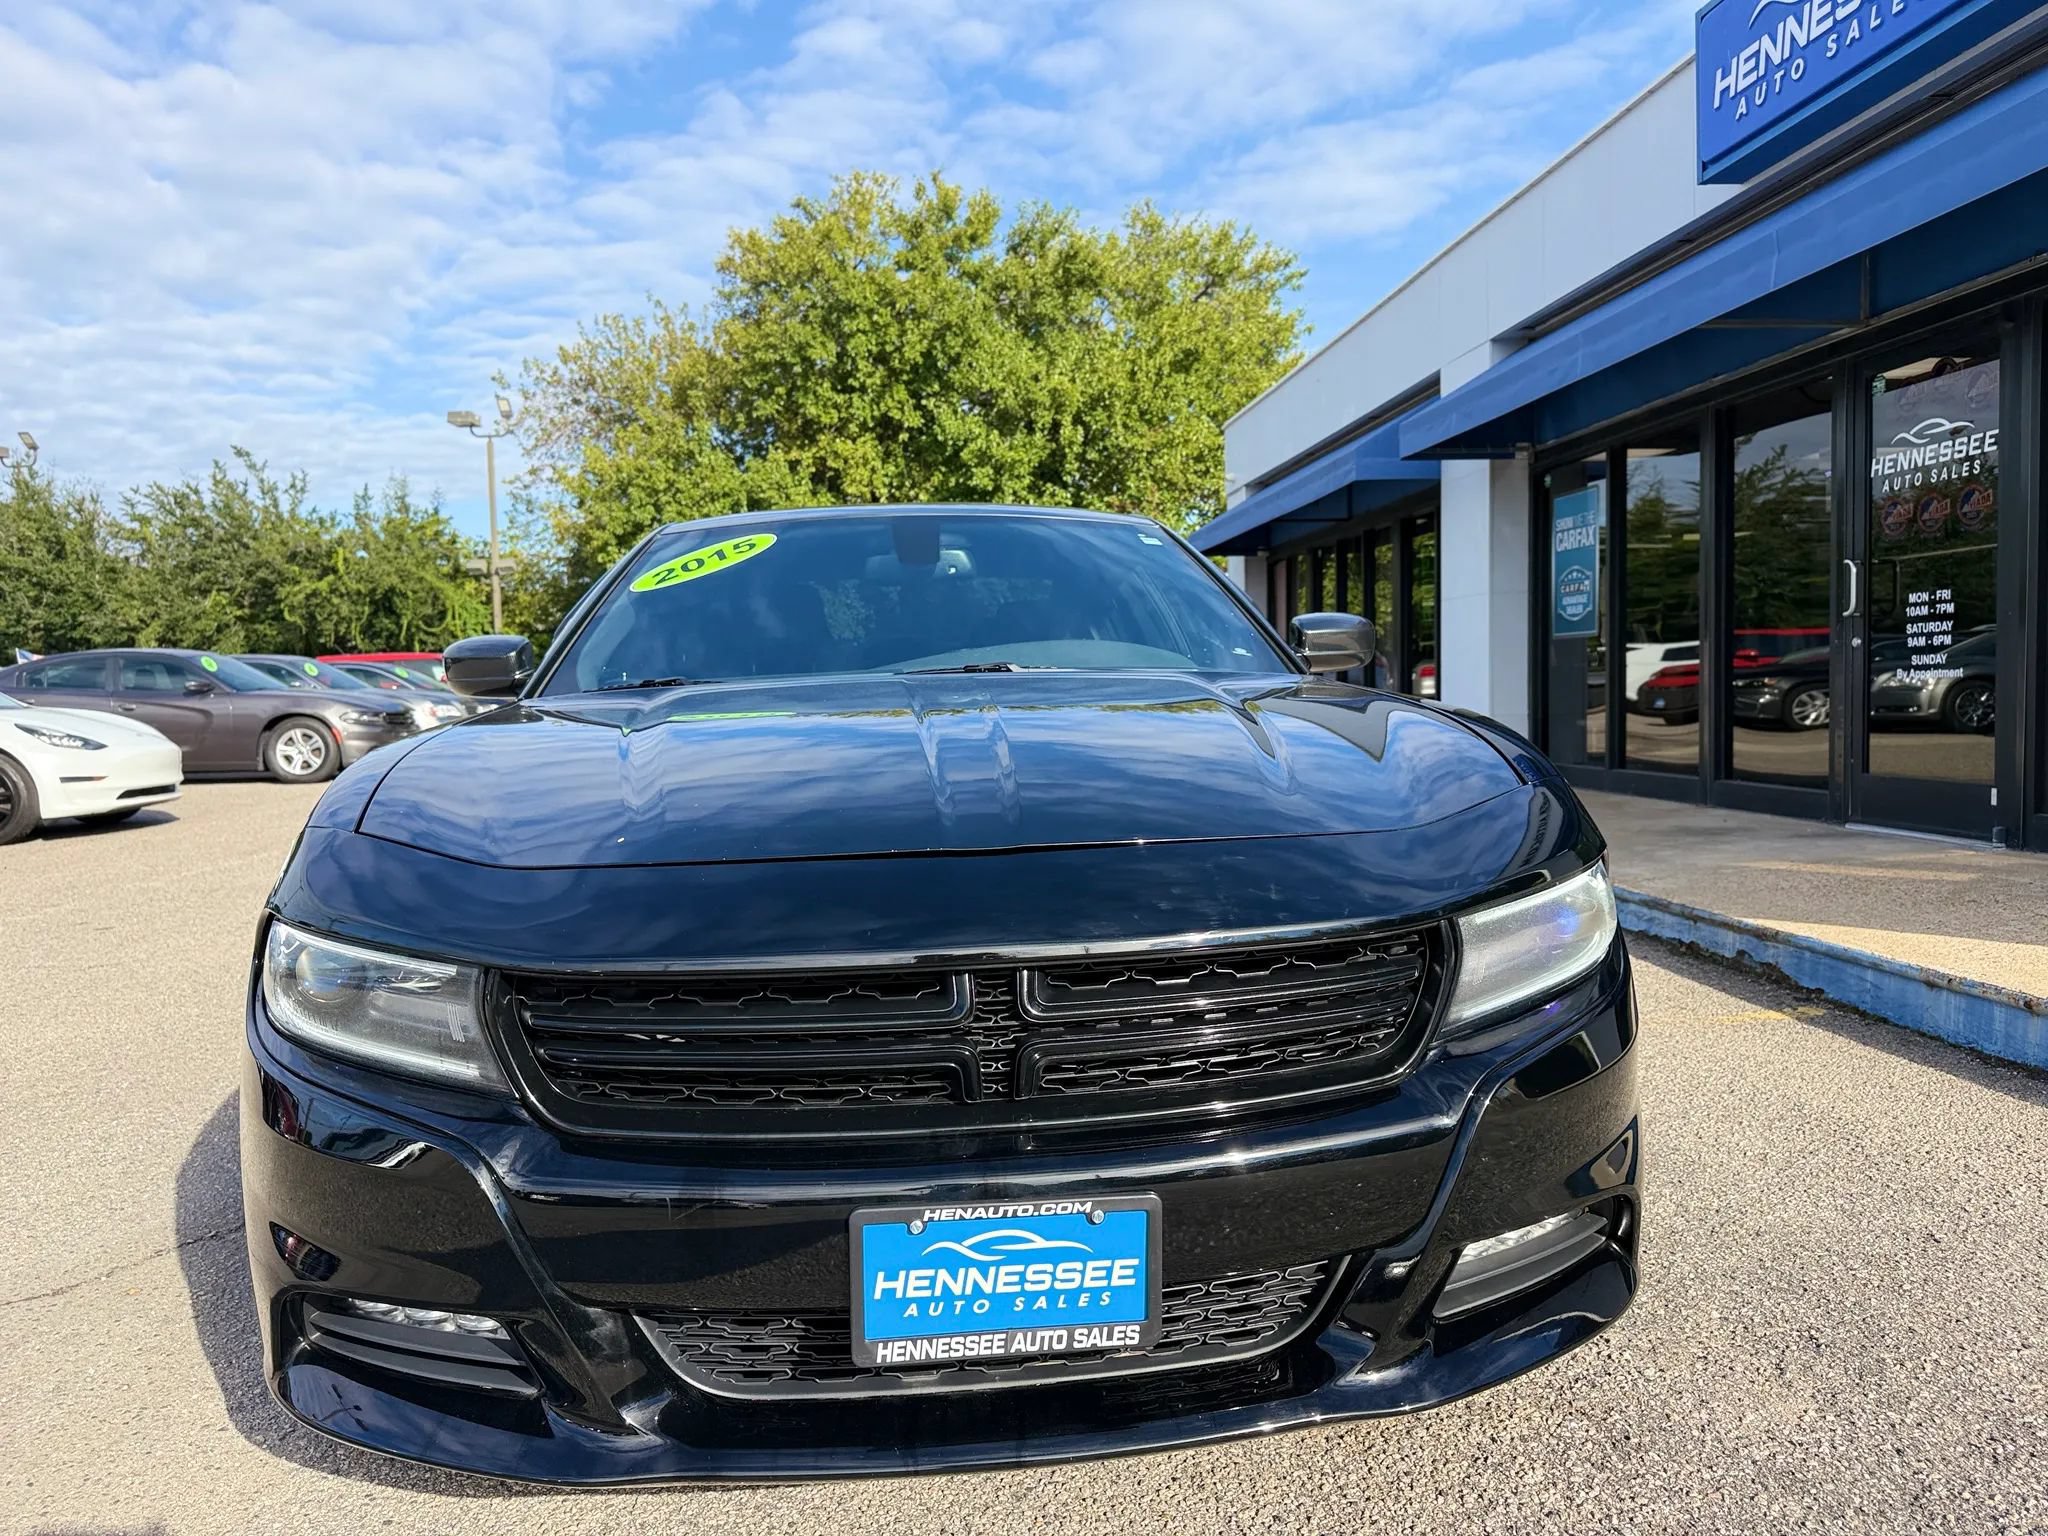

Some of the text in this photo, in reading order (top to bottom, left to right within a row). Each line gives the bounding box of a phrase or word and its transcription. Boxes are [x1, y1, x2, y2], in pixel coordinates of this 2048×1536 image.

[1735, 57, 1805, 121] AUTO
[1870, 428, 1999, 478] HENNESSEE
[1882, 459, 1981, 493] AUTO SALES
[1555, 524, 1597, 552] CARFAX
[652, 538, 757, 586] 2015
[1905, 605, 1929, 617] 10AM
[1935, 602, 1955, 615] 7PM
[1908, 591, 1929, 604] MON
[1936, 589, 1952, 601] FRI
[1906, 620, 1954, 634] SATURDAY
[1907, 636, 1926, 648] 9AM
[1932, 634, 1952, 646] 6PM
[1911, 653, 1948, 666] SUNDAY
[1896, 667, 1964, 681] By Appointment
[922, 1201, 1093, 1223] HENAUTO.COM
[873, 1258, 1140, 1300] HENNESSEE
[903, 1291, 1112, 1318] AUTO SALES
[876, 1324, 1141, 1364] HENNESSEE AUTO SALES
